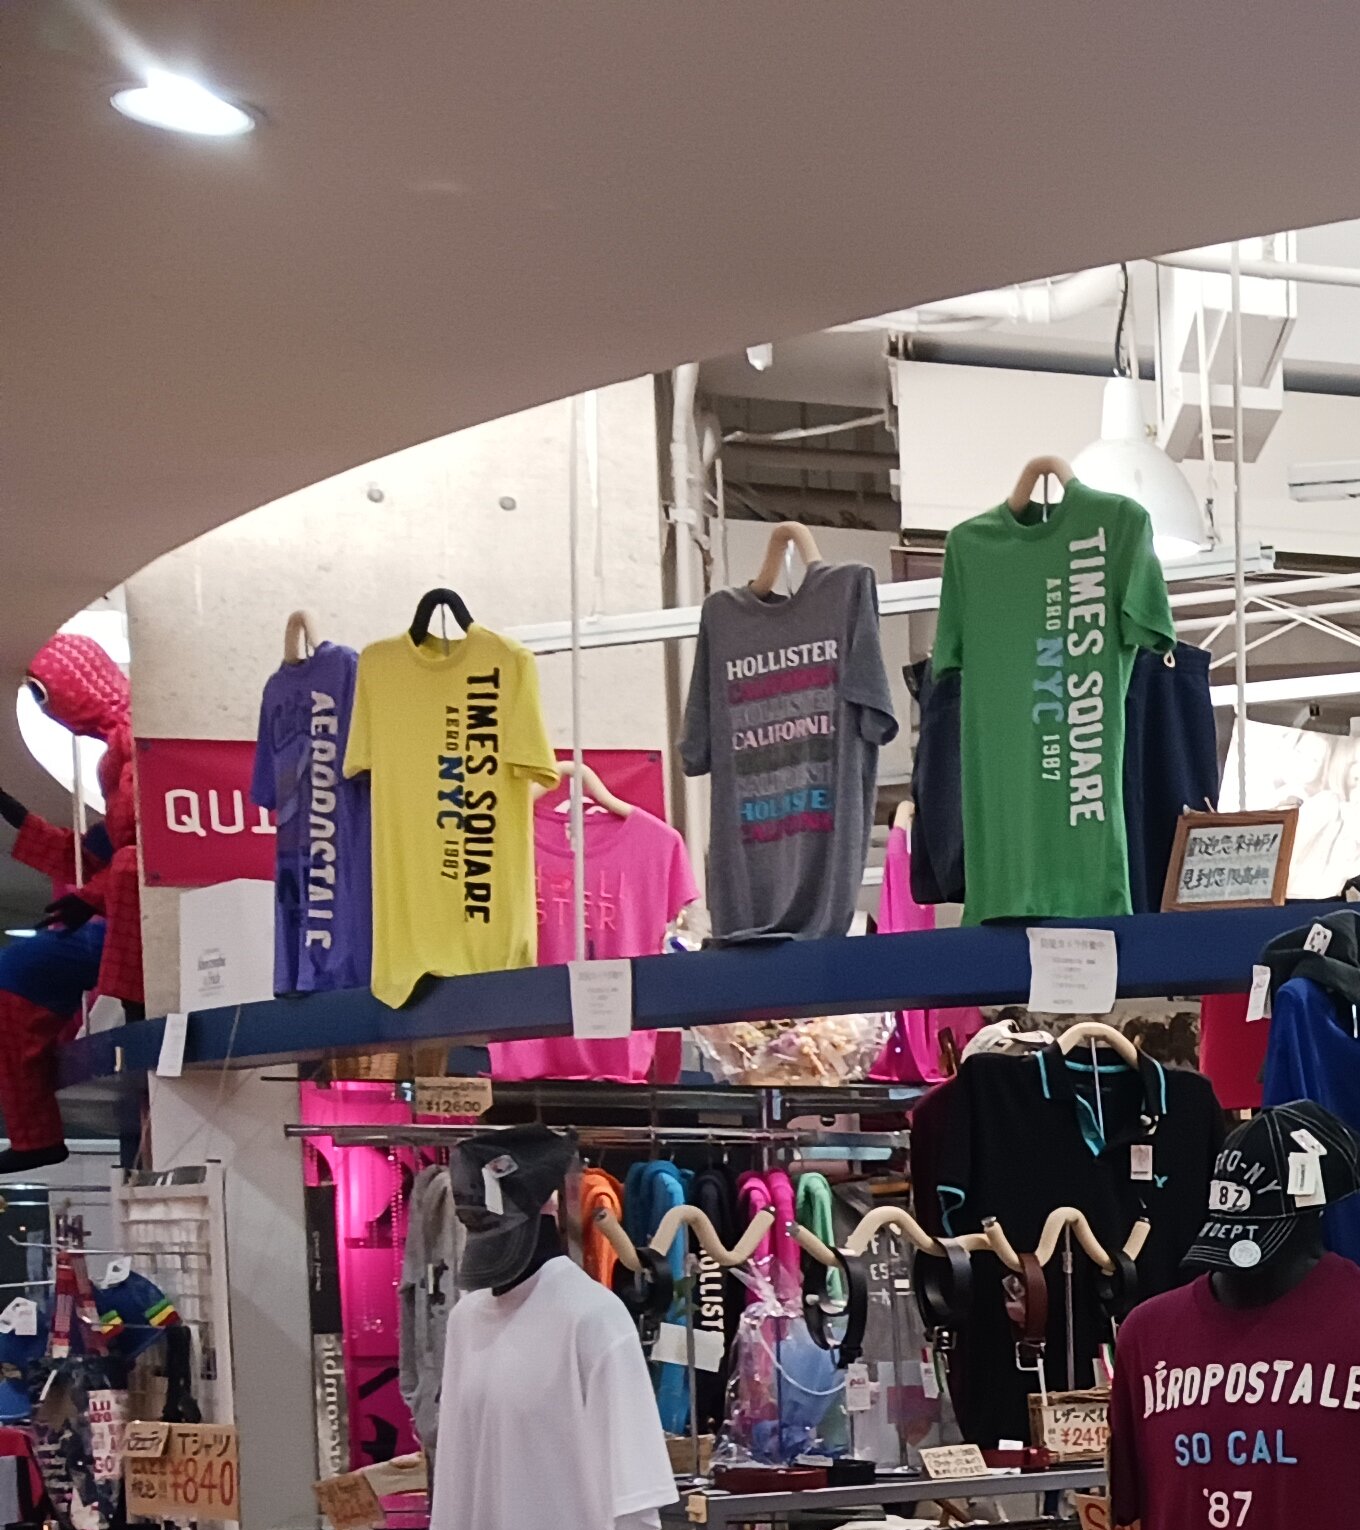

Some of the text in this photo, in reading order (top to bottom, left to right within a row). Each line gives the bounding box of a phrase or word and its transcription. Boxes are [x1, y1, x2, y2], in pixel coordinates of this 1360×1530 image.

[726, 640, 838, 681] HOLLISTER
[1032, 578, 1065, 781] AERO NYC 1987
[1067, 527, 1106, 827] TIMES SQUARE
[436, 754, 466, 831] NYC
[463, 667, 500, 924] TIMES SQUARE
[1175, 1429, 1298, 1467] SO CAL
[170, 1458, 234, 1506] ¥840
[1203, 1488, 1253, 1529] '87
